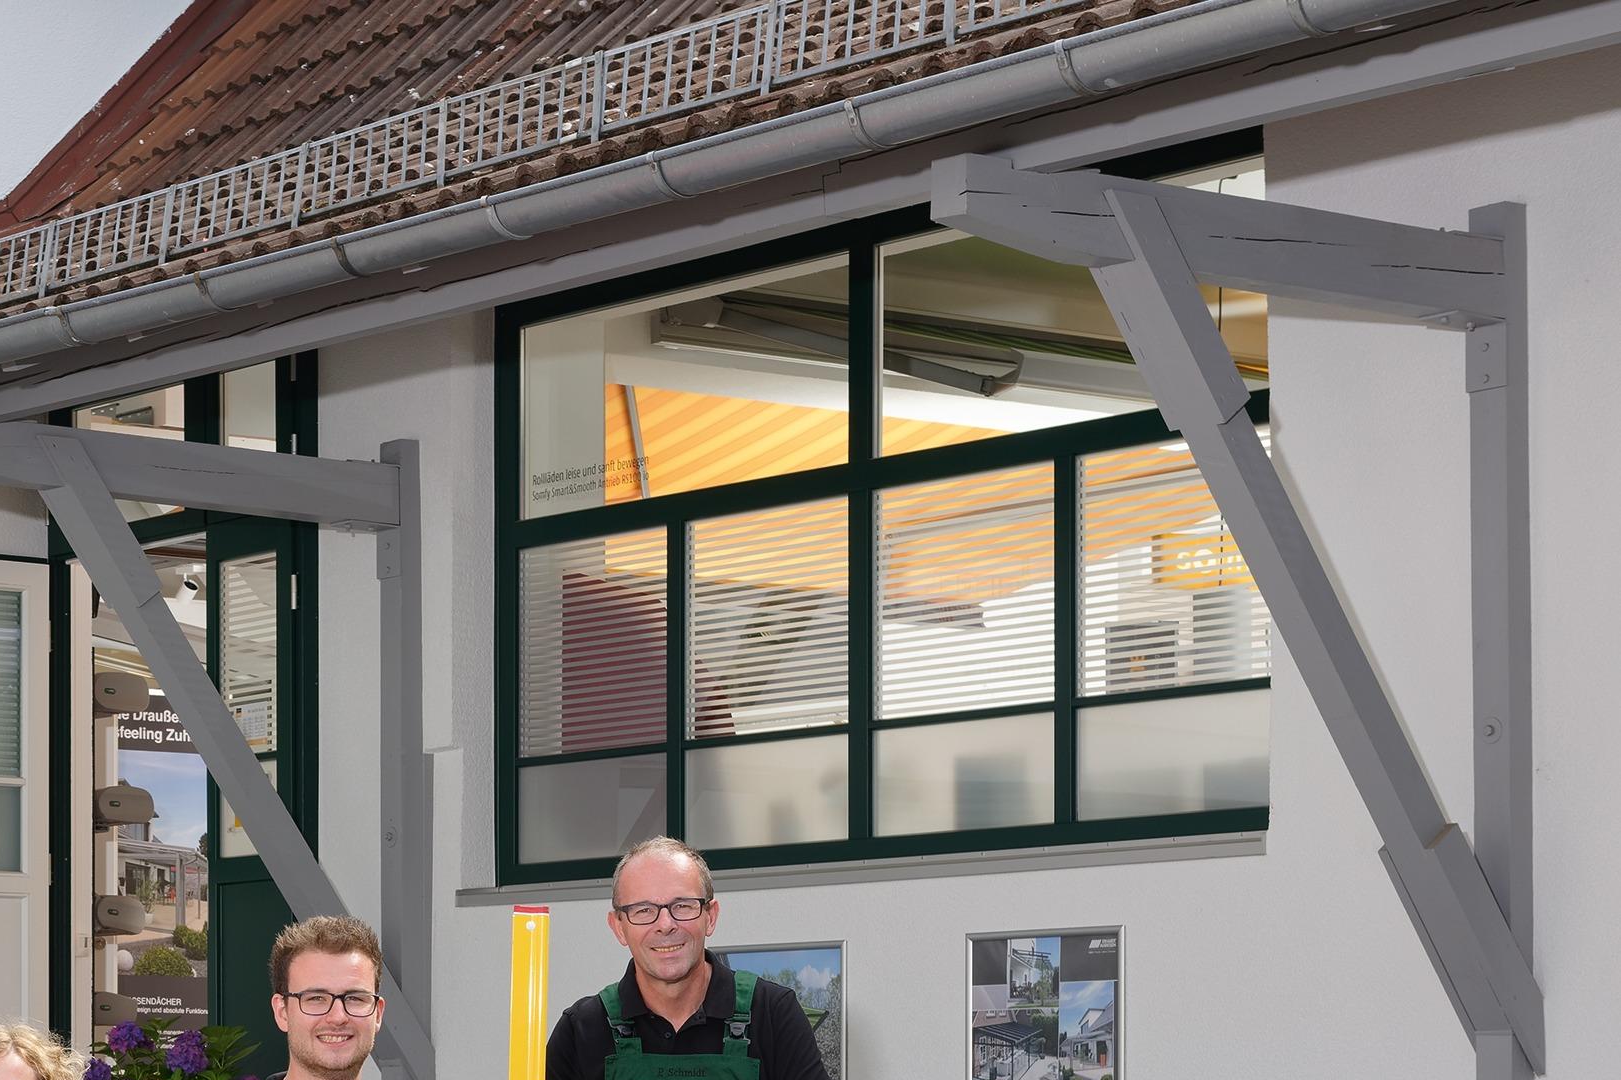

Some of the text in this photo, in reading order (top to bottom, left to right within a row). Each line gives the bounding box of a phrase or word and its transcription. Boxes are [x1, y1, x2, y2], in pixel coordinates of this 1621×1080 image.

[565, 467, 581, 480] leise
[582, 464, 597, 476] und
[597, 459, 615, 473] sanft
[617, 455, 650, 470] bewegen
[532, 487, 550, 501] Somfy
[551, 480, 597, 497] Smart&Smooth
[133, 710, 181, 723] Drauße
[132, 996, 182, 1006] SENDÄCHER
